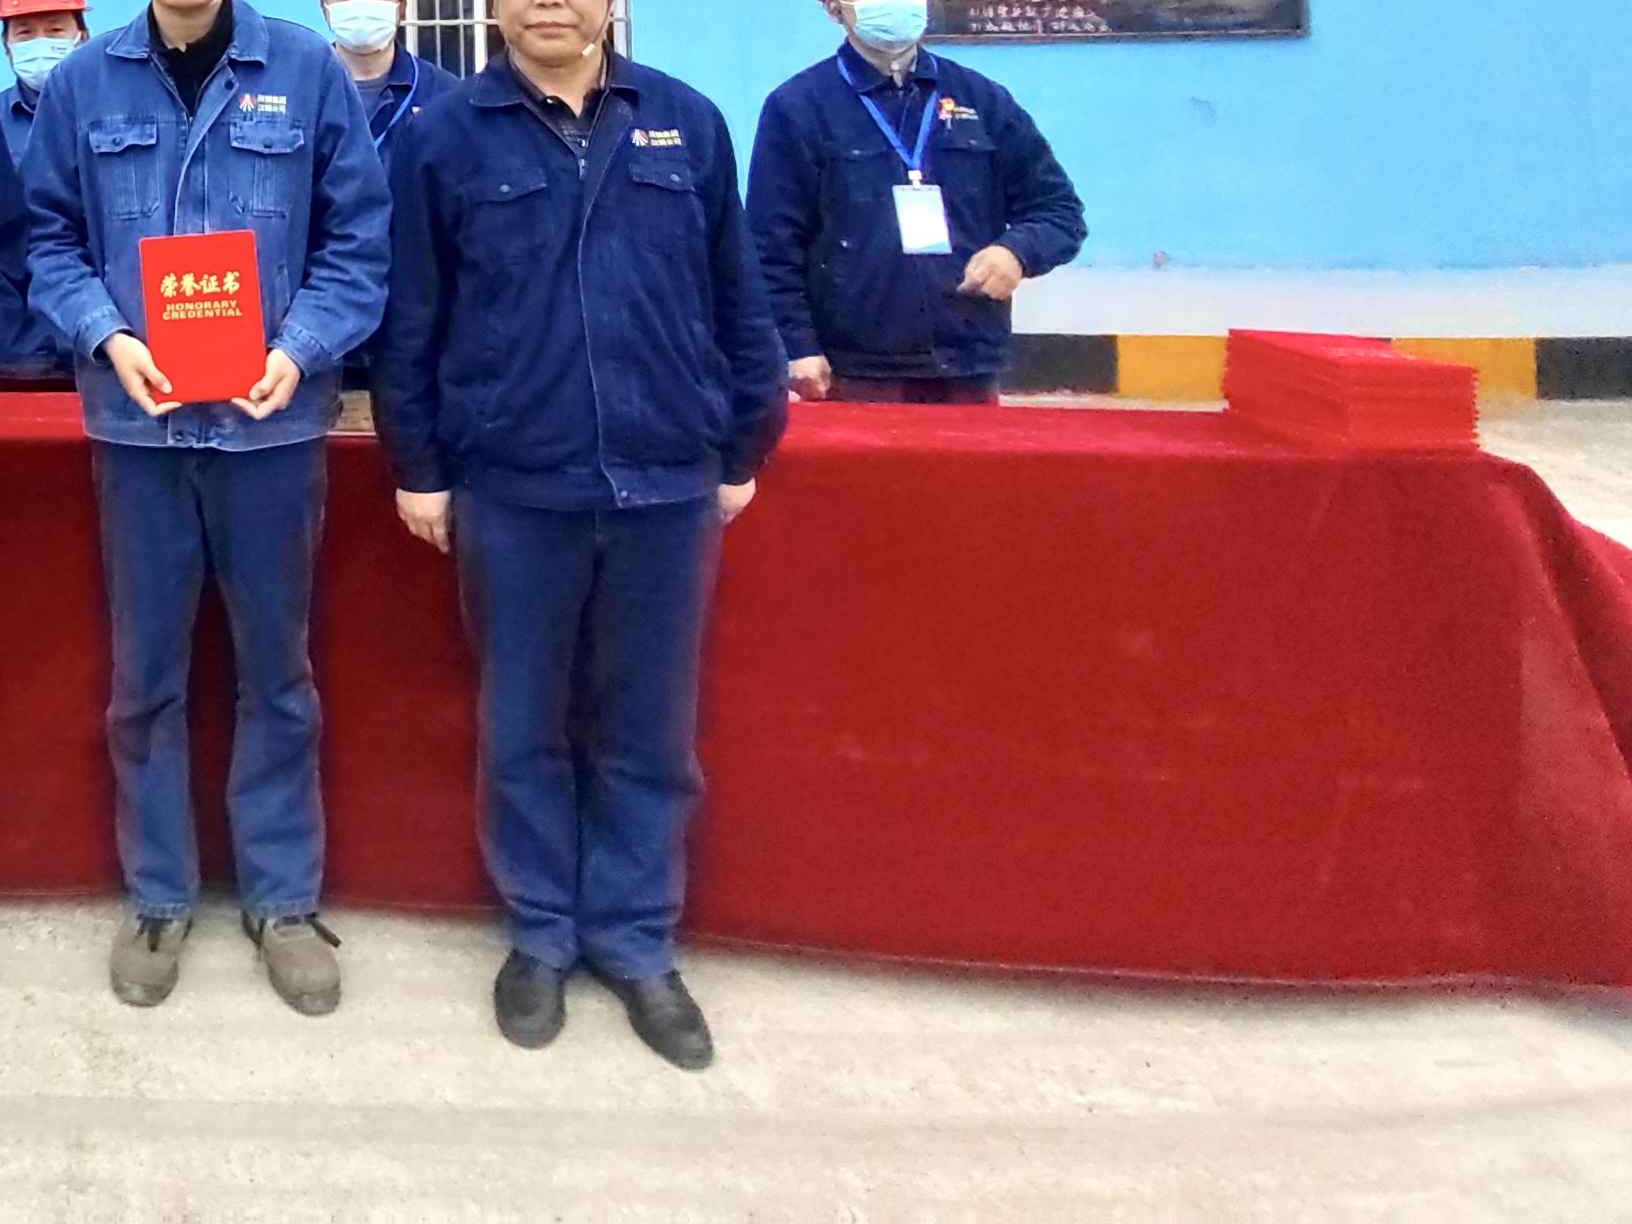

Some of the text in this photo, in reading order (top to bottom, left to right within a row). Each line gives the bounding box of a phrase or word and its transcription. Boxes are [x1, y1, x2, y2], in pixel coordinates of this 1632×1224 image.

[160, 271, 241, 298] 荣誉证书
[166, 300, 237, 311] HONORARY
[162, 308, 243, 320] CREDENTIAL
